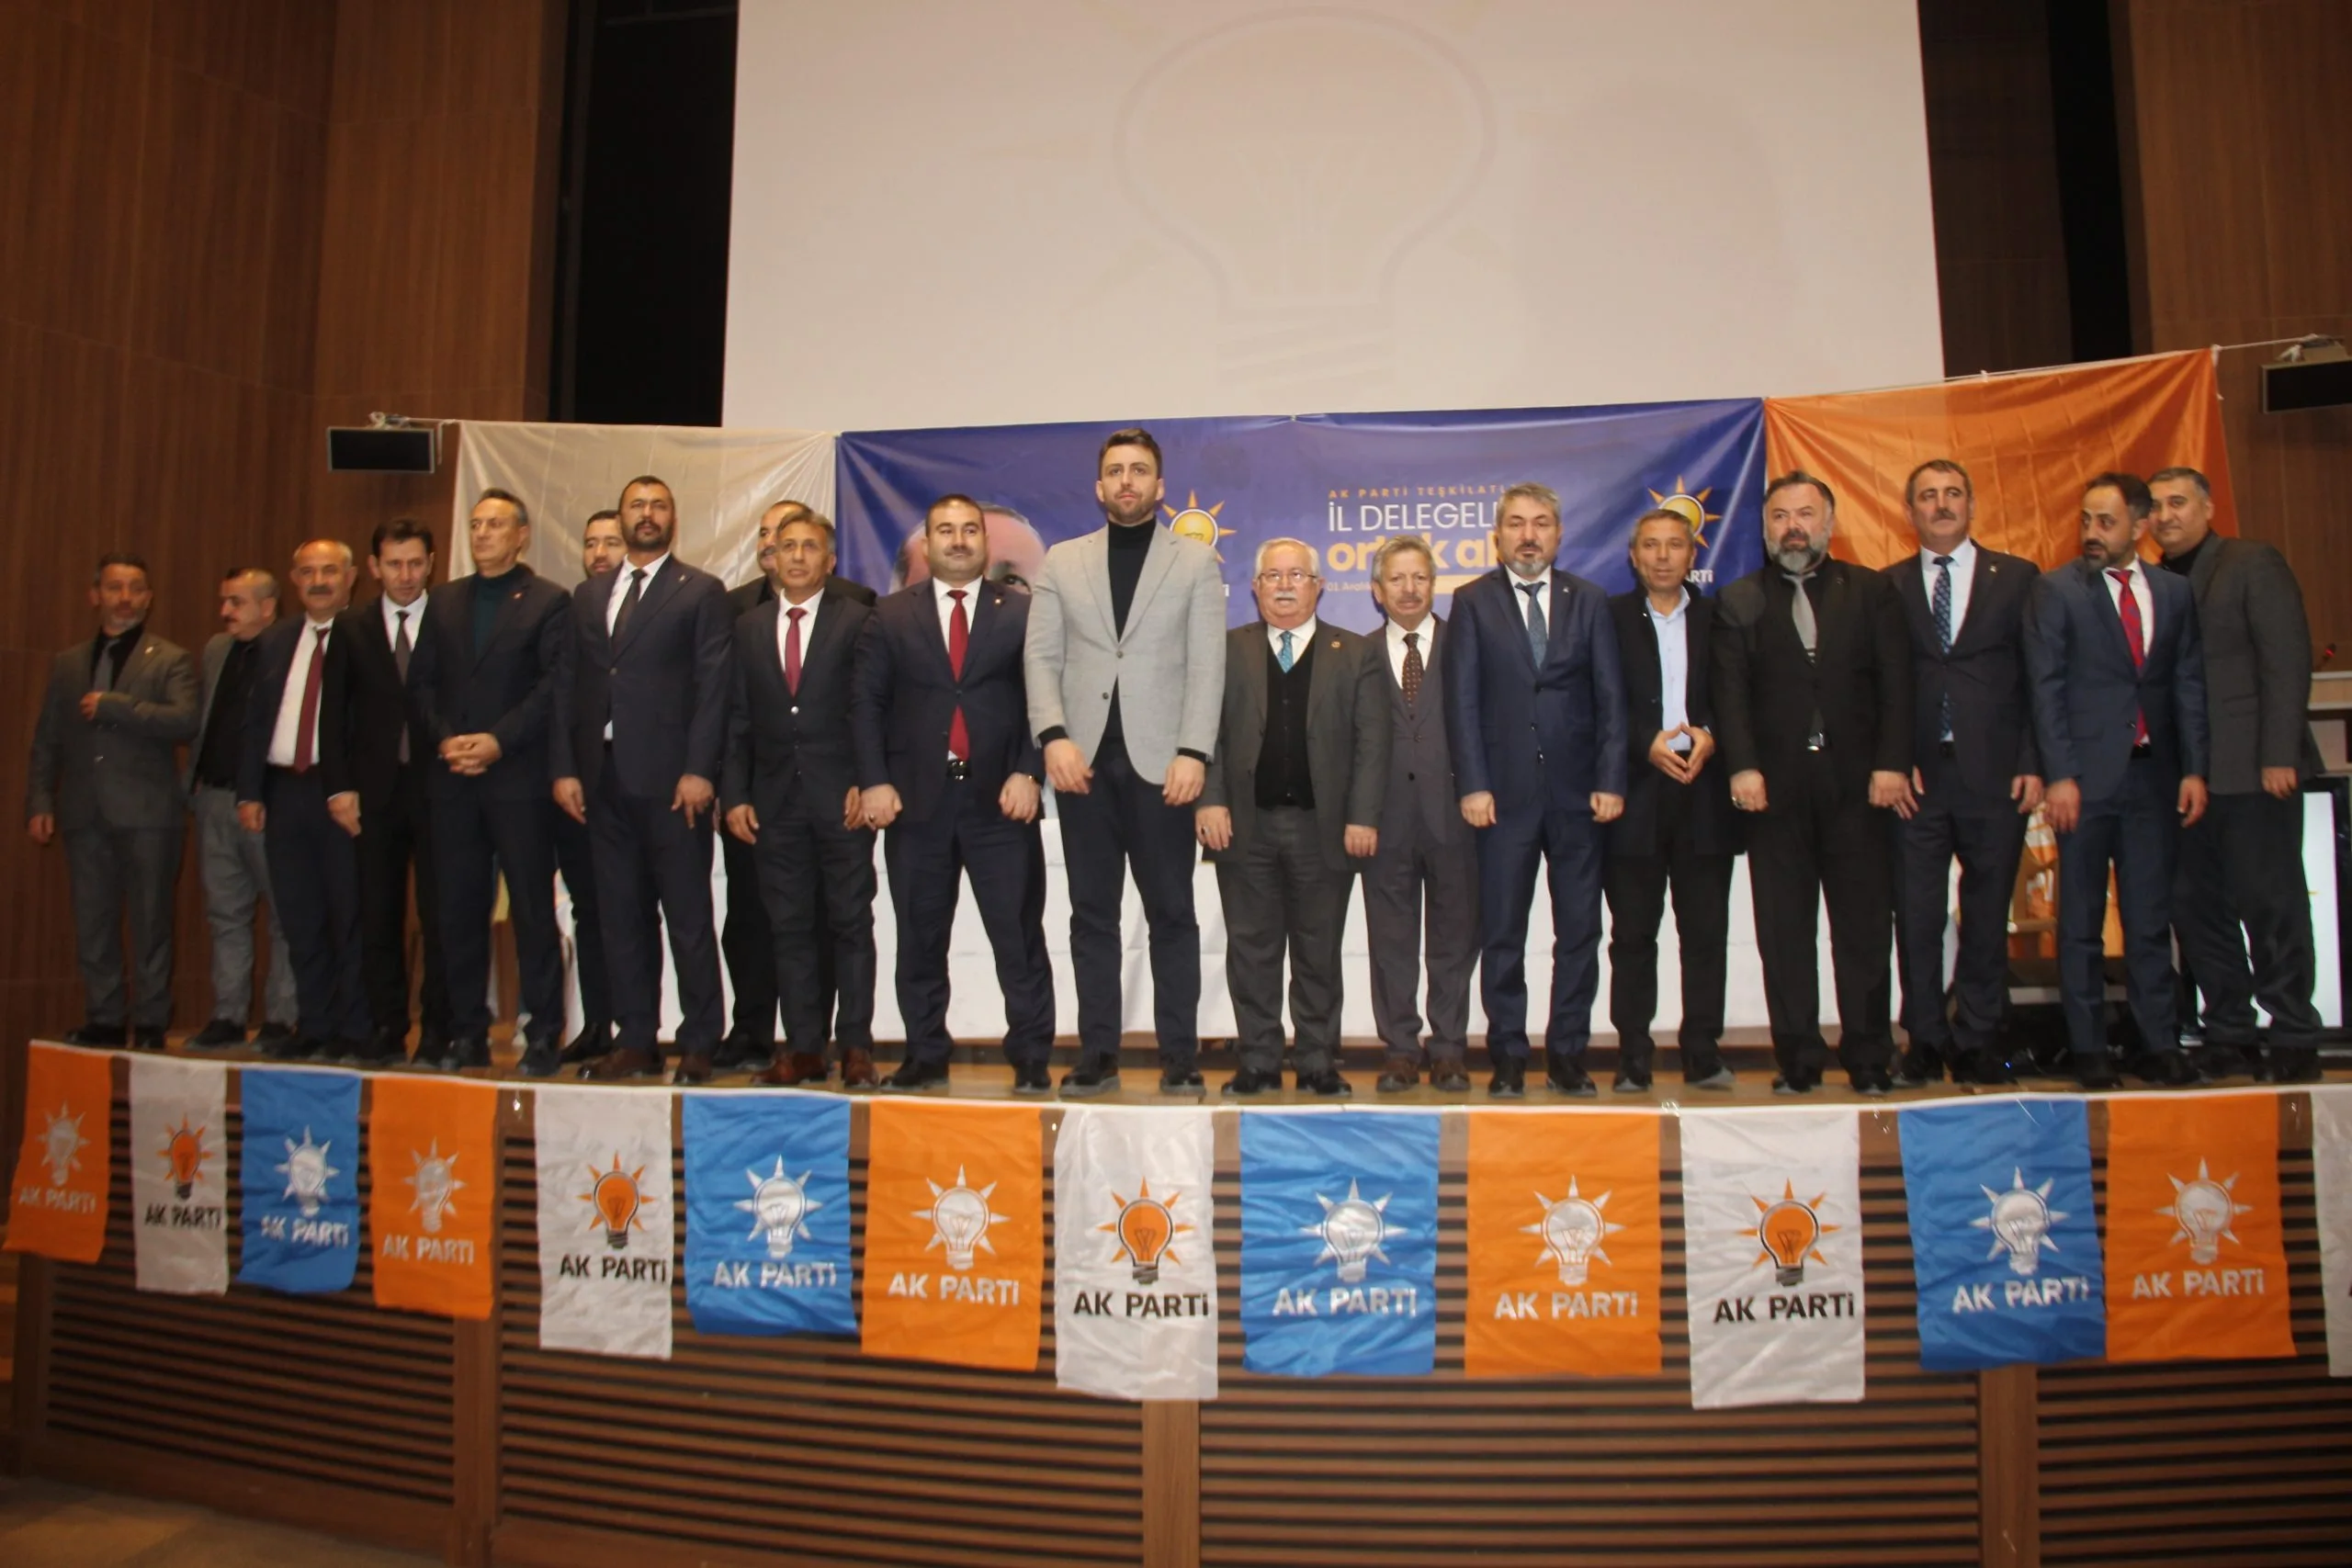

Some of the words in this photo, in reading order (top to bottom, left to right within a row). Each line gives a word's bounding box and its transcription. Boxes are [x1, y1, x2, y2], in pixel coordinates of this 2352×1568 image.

[1329, 490, 1349, 499] AK
[1329, 502, 1352, 532] İL
[18, 1187, 40, 1206] AK
[144, 1203, 167, 1225] AK
[382, 1234, 410, 1260] AK
[560, 1255, 592, 1279] AK
[713, 1261, 751, 1287] AK
[888, 1272, 930, 1300] AK
[2132, 1273, 2173, 1299] AK
[1073, 1291, 1114, 1316] AK
[1272, 1288, 1317, 1316] AK
[1494, 1292, 1539, 1319] AK
[1713, 1298, 1756, 1324] AK
[1952, 1285, 1996, 1314] AK
